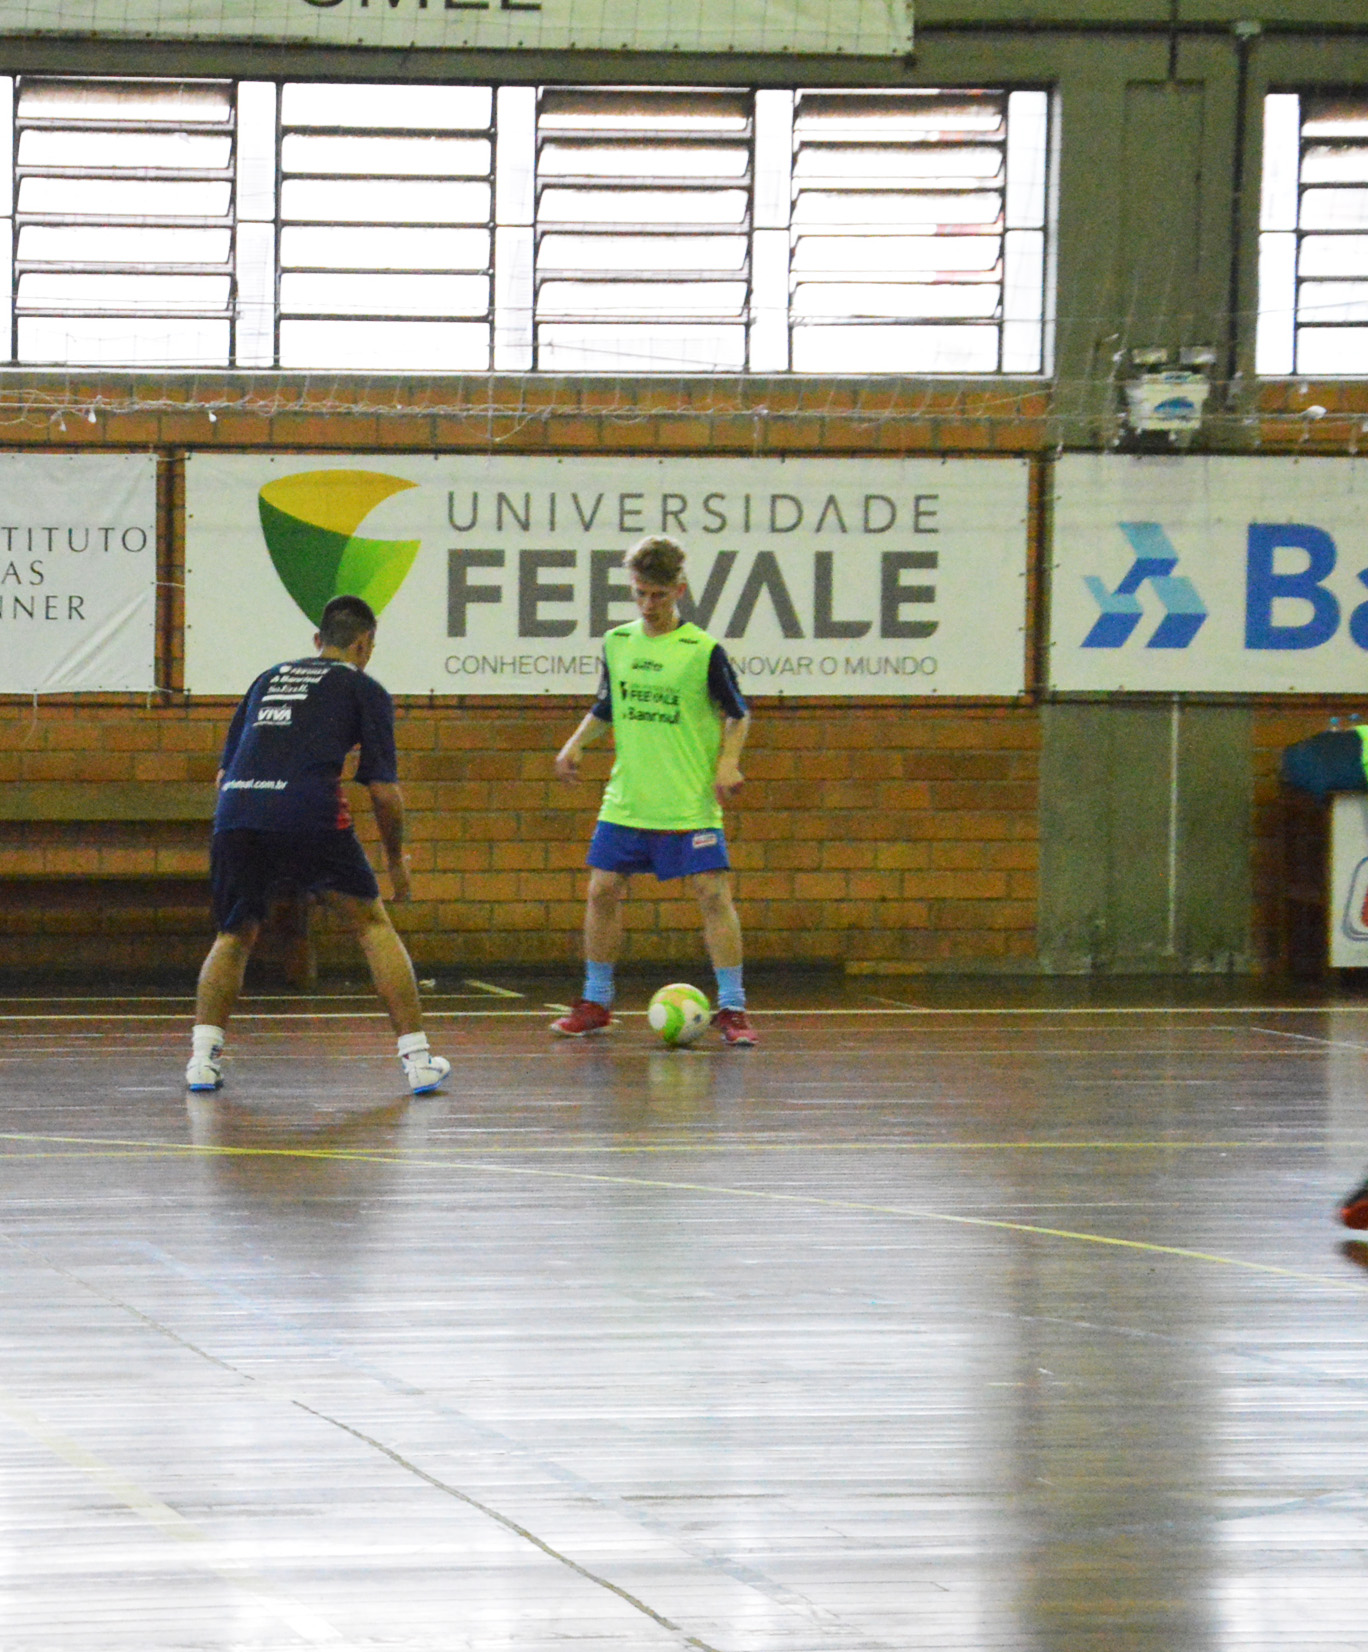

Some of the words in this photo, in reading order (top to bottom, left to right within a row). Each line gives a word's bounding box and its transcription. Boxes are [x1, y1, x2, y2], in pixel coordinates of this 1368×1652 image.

[447, 492, 941, 534] UNIVERSIDADE
[446, 548, 941, 639] FEEVALE
[1244, 522, 1368, 652] B
[729, 655, 812, 675] NOVAR
[819, 655, 839, 675] O
[844, 655, 938, 675] MUNDO
